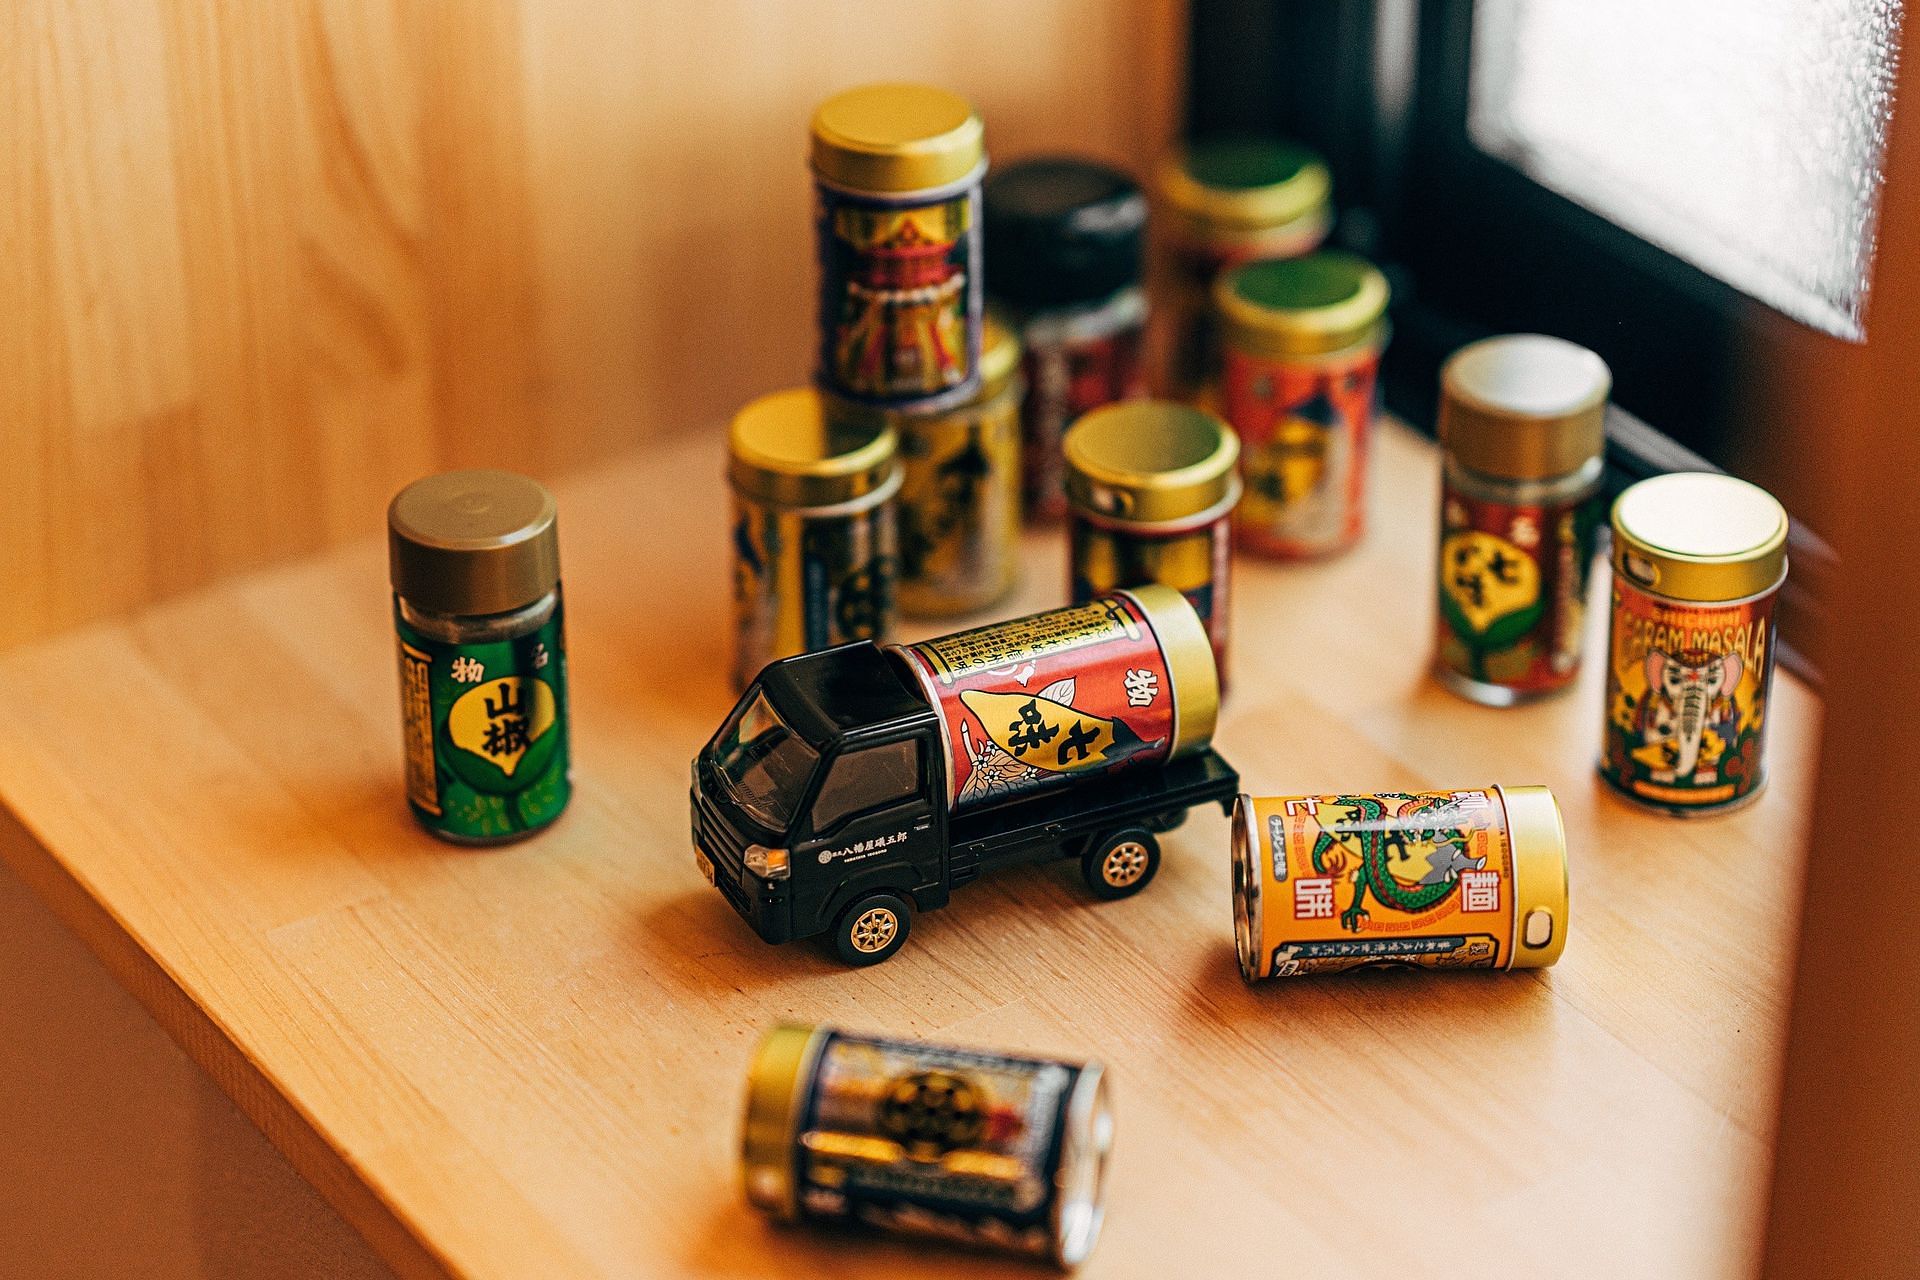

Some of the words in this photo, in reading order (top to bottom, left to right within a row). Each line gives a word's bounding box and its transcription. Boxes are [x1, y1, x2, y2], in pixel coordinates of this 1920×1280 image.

[451, 656, 484, 683] 物
[1692, 617, 1766, 682] MASALA
[1123, 668, 1161, 708] 物
[482, 683, 535, 757] 山椒
[1008, 699, 1100, 765] 七味
[1295, 878, 1336, 920] 味
